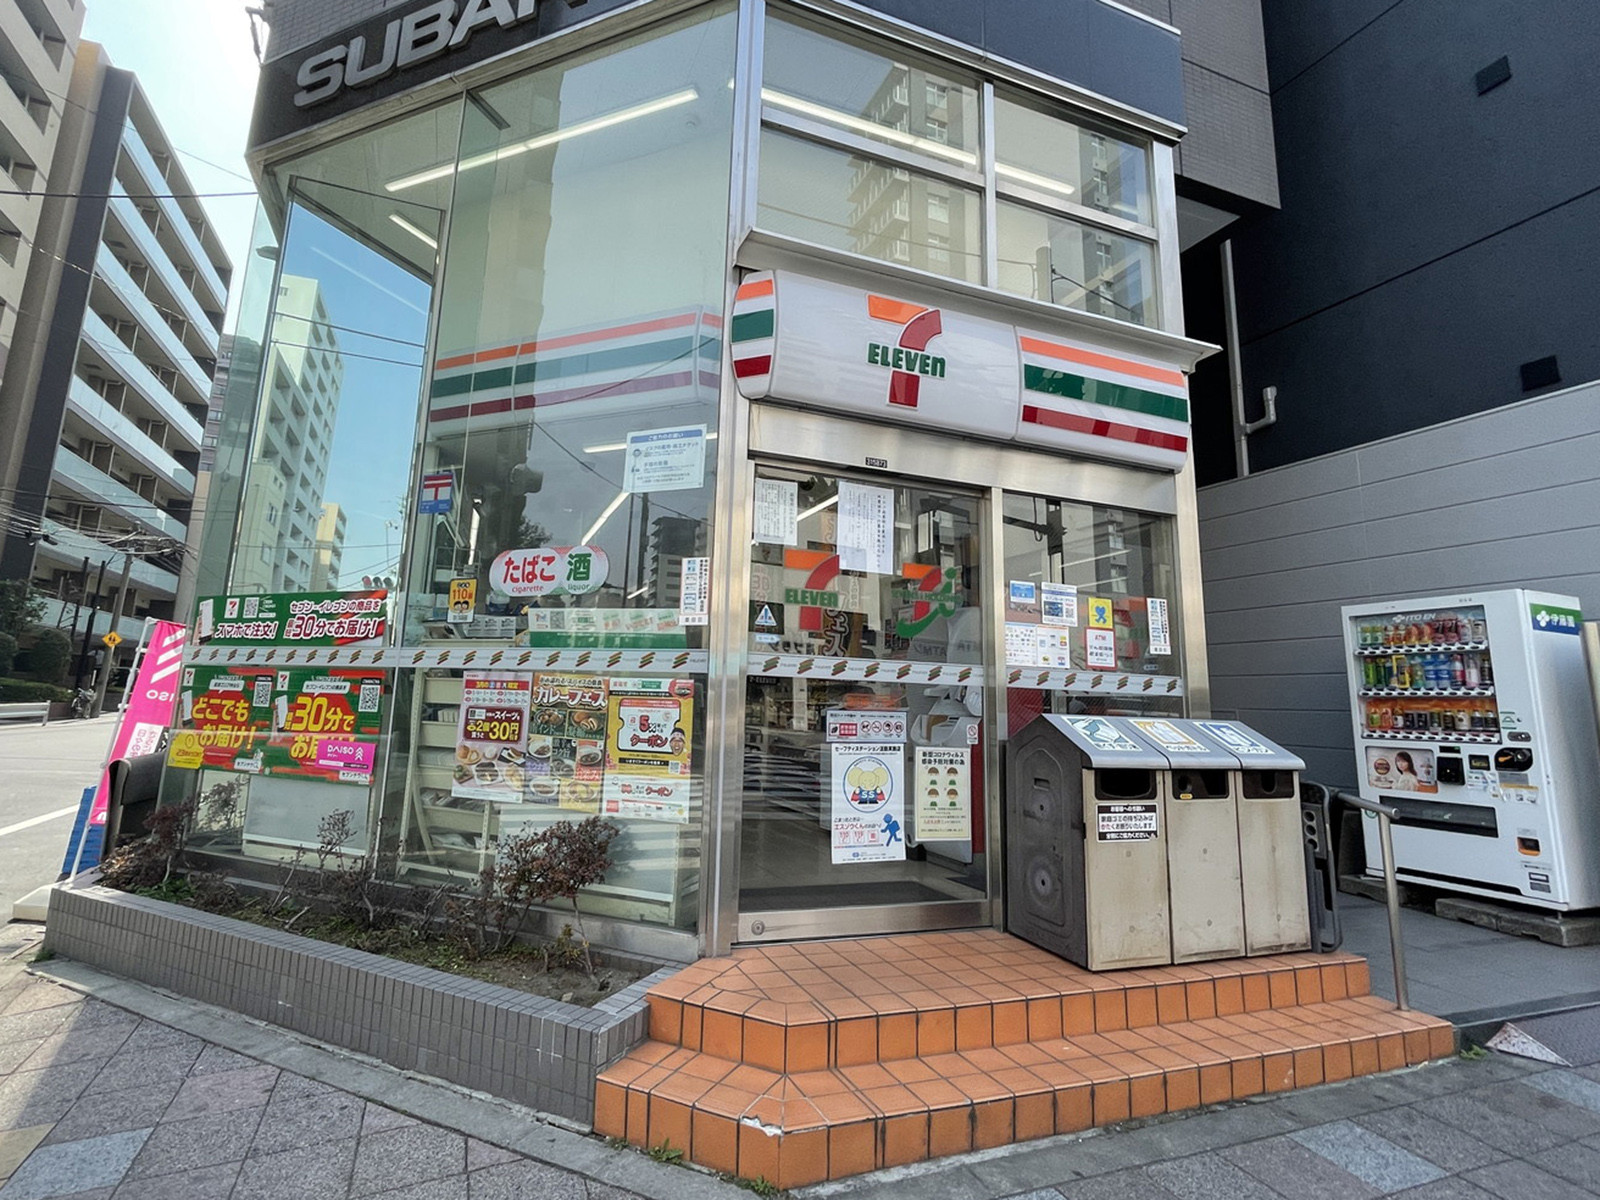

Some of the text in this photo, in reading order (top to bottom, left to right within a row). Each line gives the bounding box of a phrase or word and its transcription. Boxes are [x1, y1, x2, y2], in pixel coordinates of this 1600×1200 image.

[867, 294, 942, 408] 7
[503, 553, 592, 583] たばこ 酒
[512, 585, 543, 594] cigarette
[534, 687, 607, 708] カレーフェス
[192, 697, 249, 722] どこでも
[327, 744, 355, 755] DAISO
[630, 733, 668, 748] クーポン
